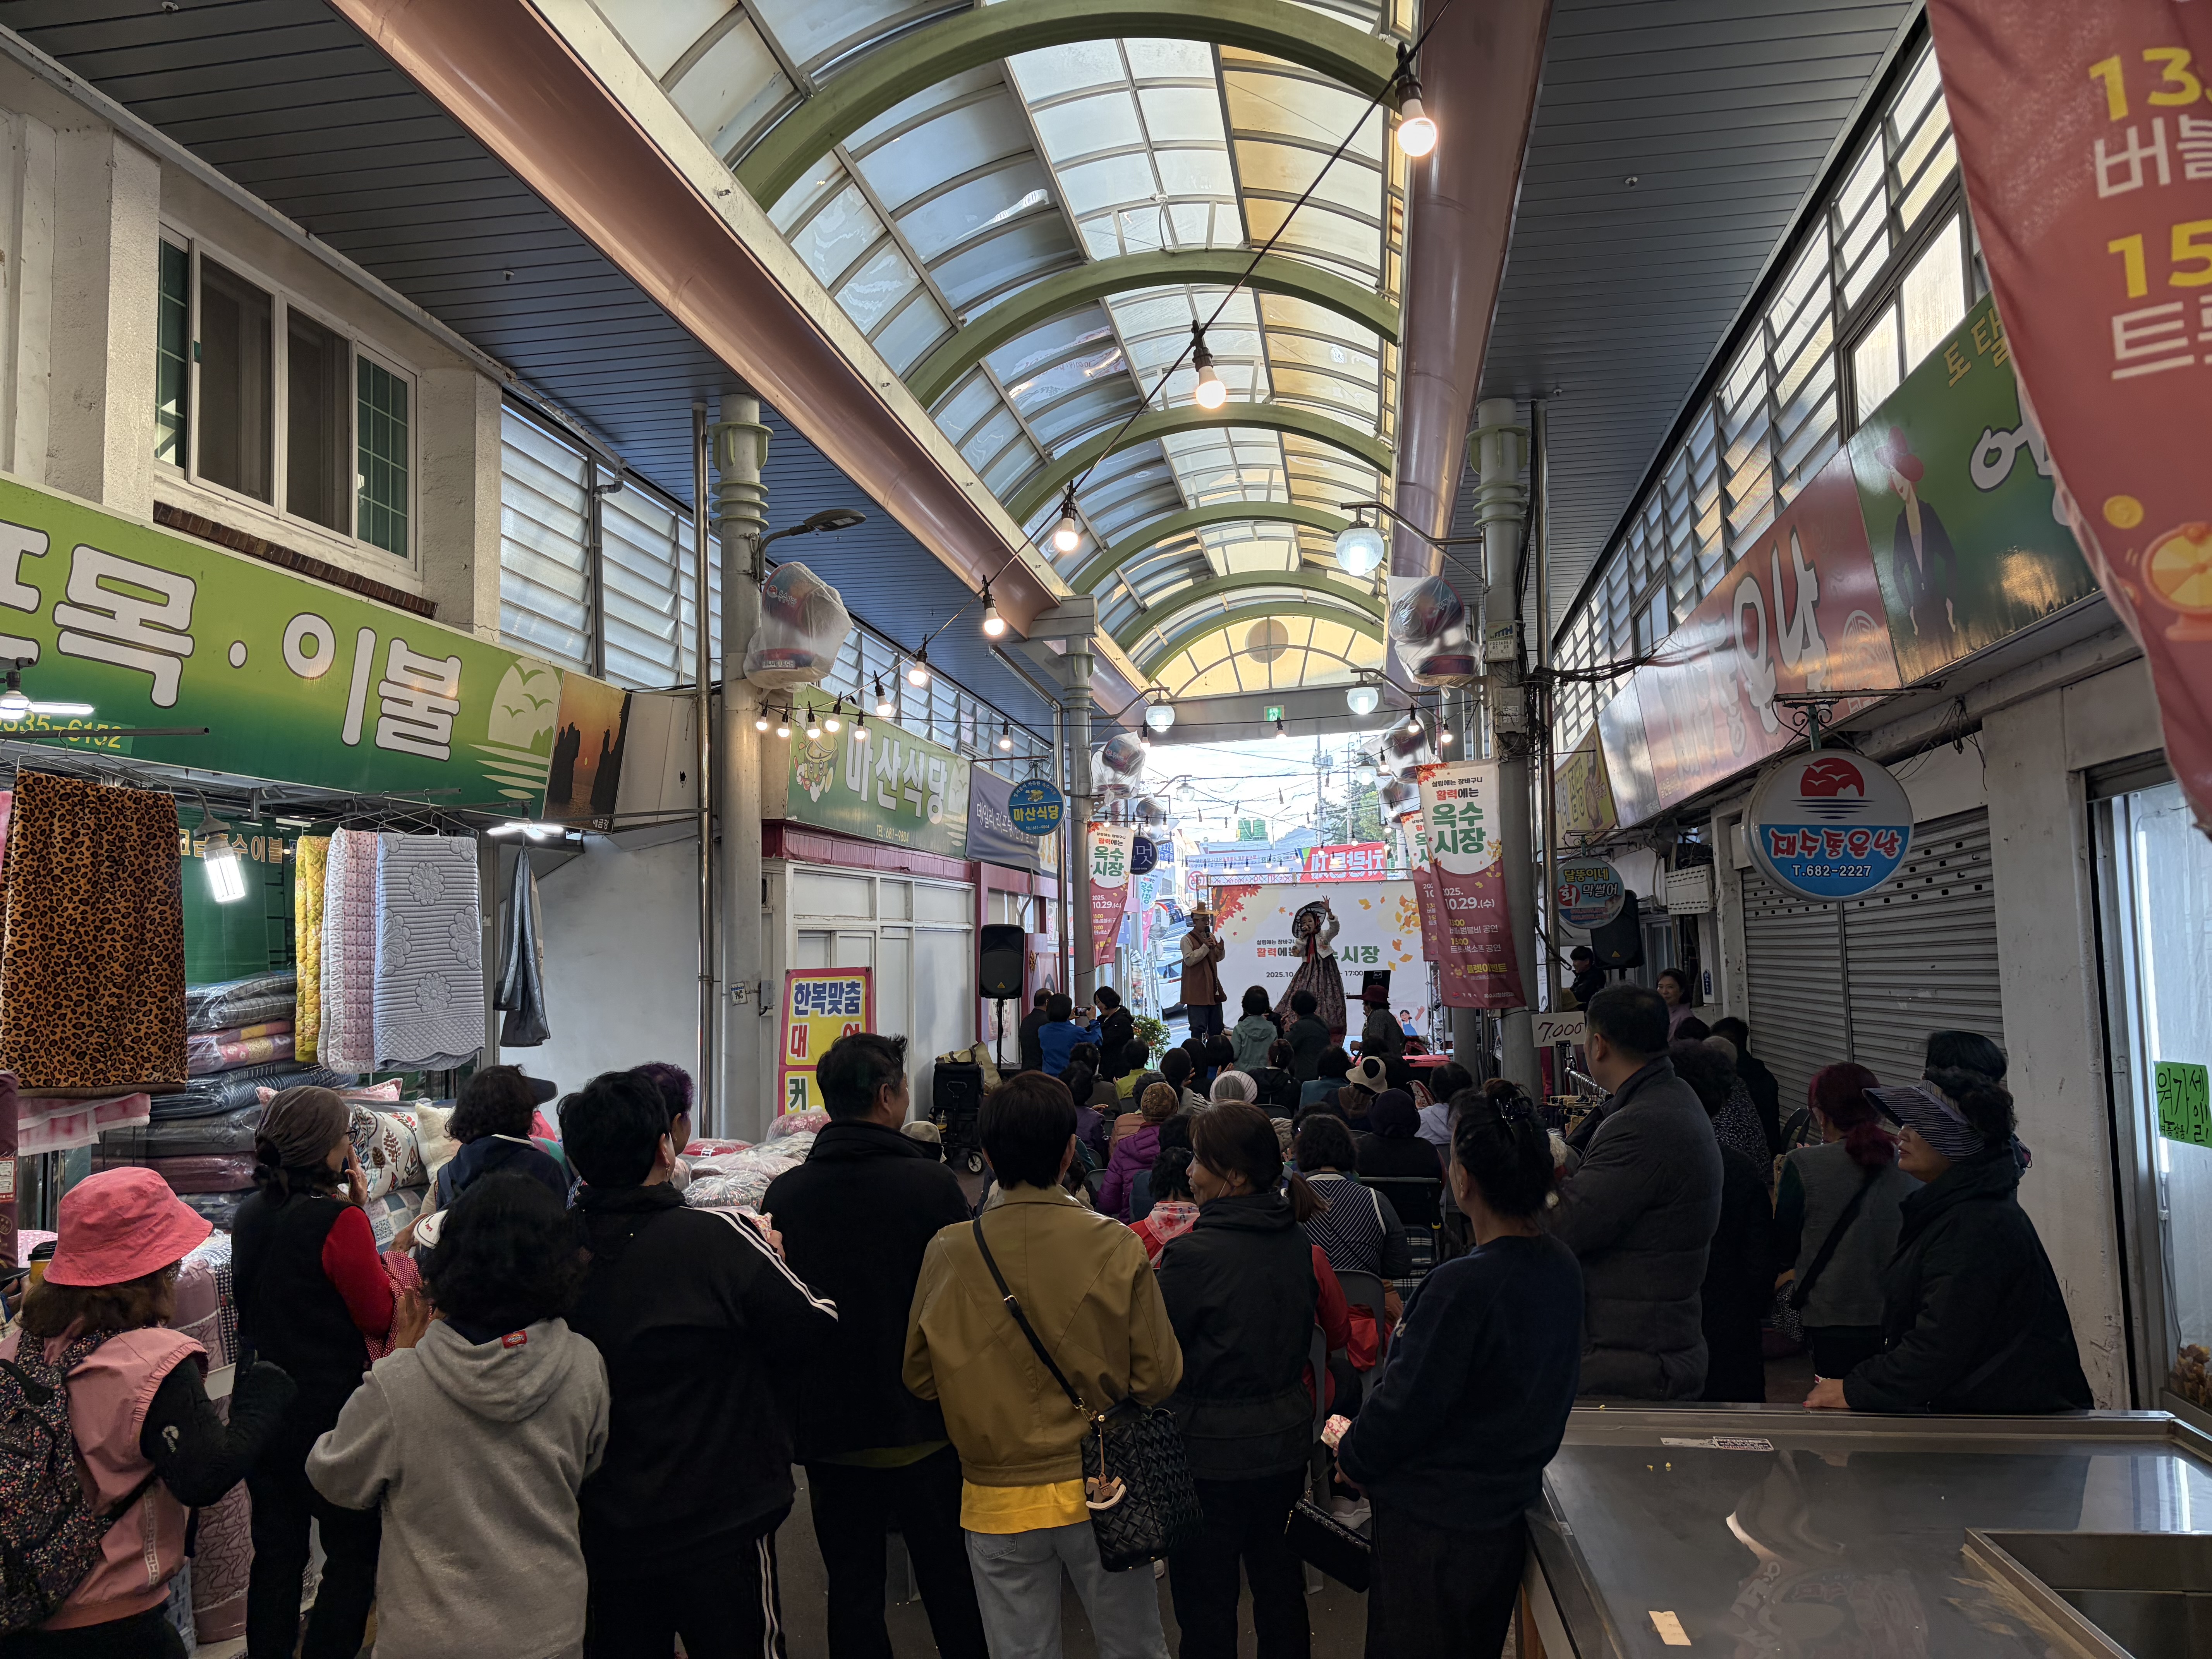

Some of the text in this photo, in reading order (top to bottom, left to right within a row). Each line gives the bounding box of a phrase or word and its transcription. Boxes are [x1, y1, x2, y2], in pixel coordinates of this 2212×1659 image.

[2111, 295, 2212, 380] 트
[1494, 625, 1513, 638] FTTH
[282, 612, 463, 763] 이불
[845, 719, 948, 825] 마산식당
[1432, 776, 1483, 788] 살림에는 장바구니
[1436, 787, 1479, 801] 활력에는
[1013, 805, 1060, 822] 마산식당
[1432, 801, 1484, 829] 옥수
[1434, 827, 1486, 855] 시장
[1094, 846, 1124, 862] 옥수
[1135, 843, 1152, 865] 멋
[1093, 861, 1124, 877] 시장
[1564, 867, 1609, 883] 달뚱이네
[1792, 865, 1872, 877] T.682-2227
[1559, 883, 1618, 907] 회 막썰어
[1483, 924, 1498, 933] 공연
[1486, 943, 1501, 952] 공연
[794, 981, 861, 1016] 한복맞춤
[790, 1024, 808, 1058] 대
[789, 1077, 807, 1111] 커
